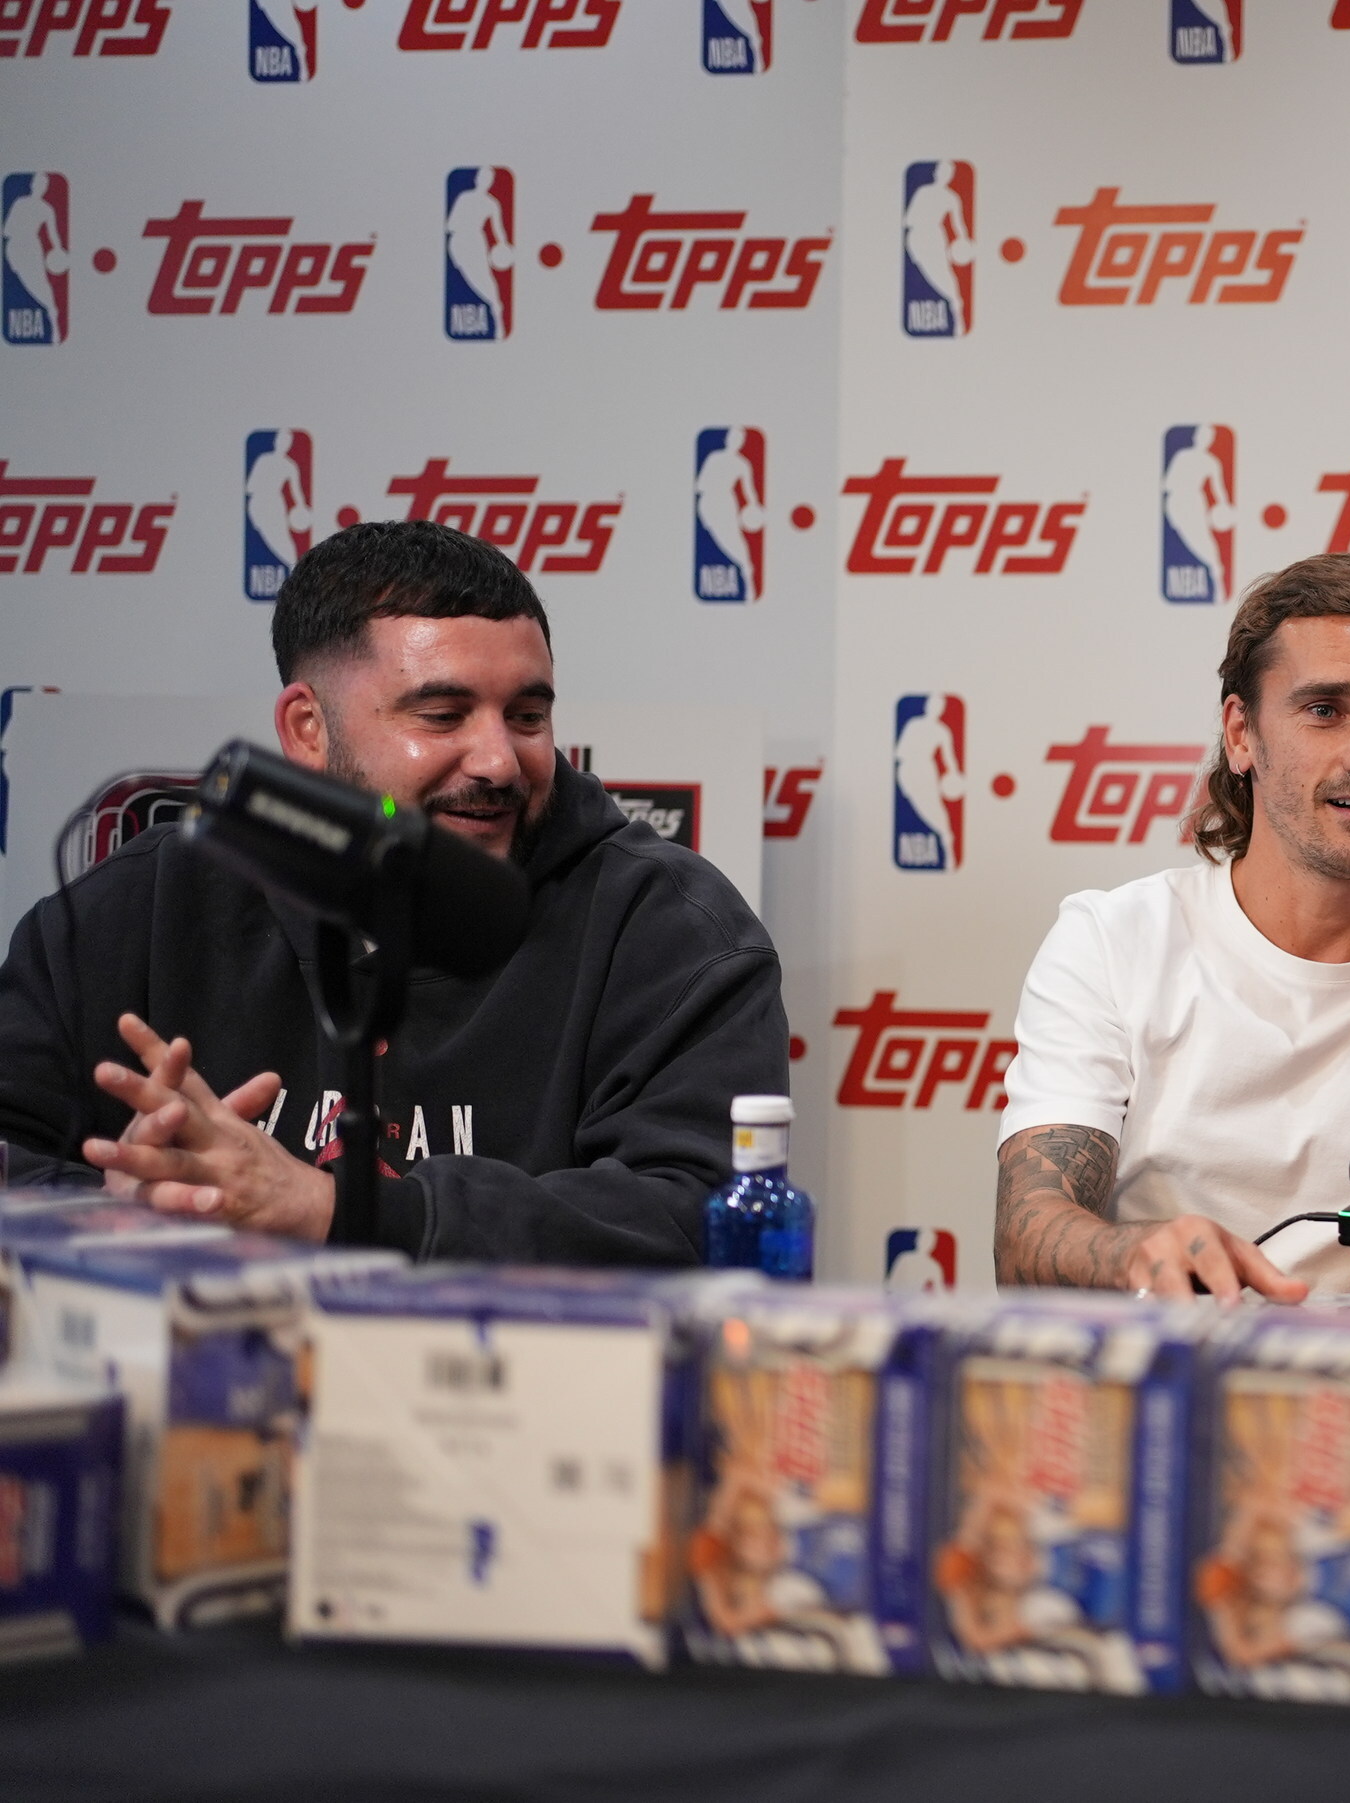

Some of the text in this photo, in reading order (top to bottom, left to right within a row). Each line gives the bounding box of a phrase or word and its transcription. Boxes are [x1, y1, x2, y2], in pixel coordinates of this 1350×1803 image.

[256, 46, 293, 77] NBA
[8, 308, 45, 339] NBA
[832, 988, 1020, 1113] Topp
